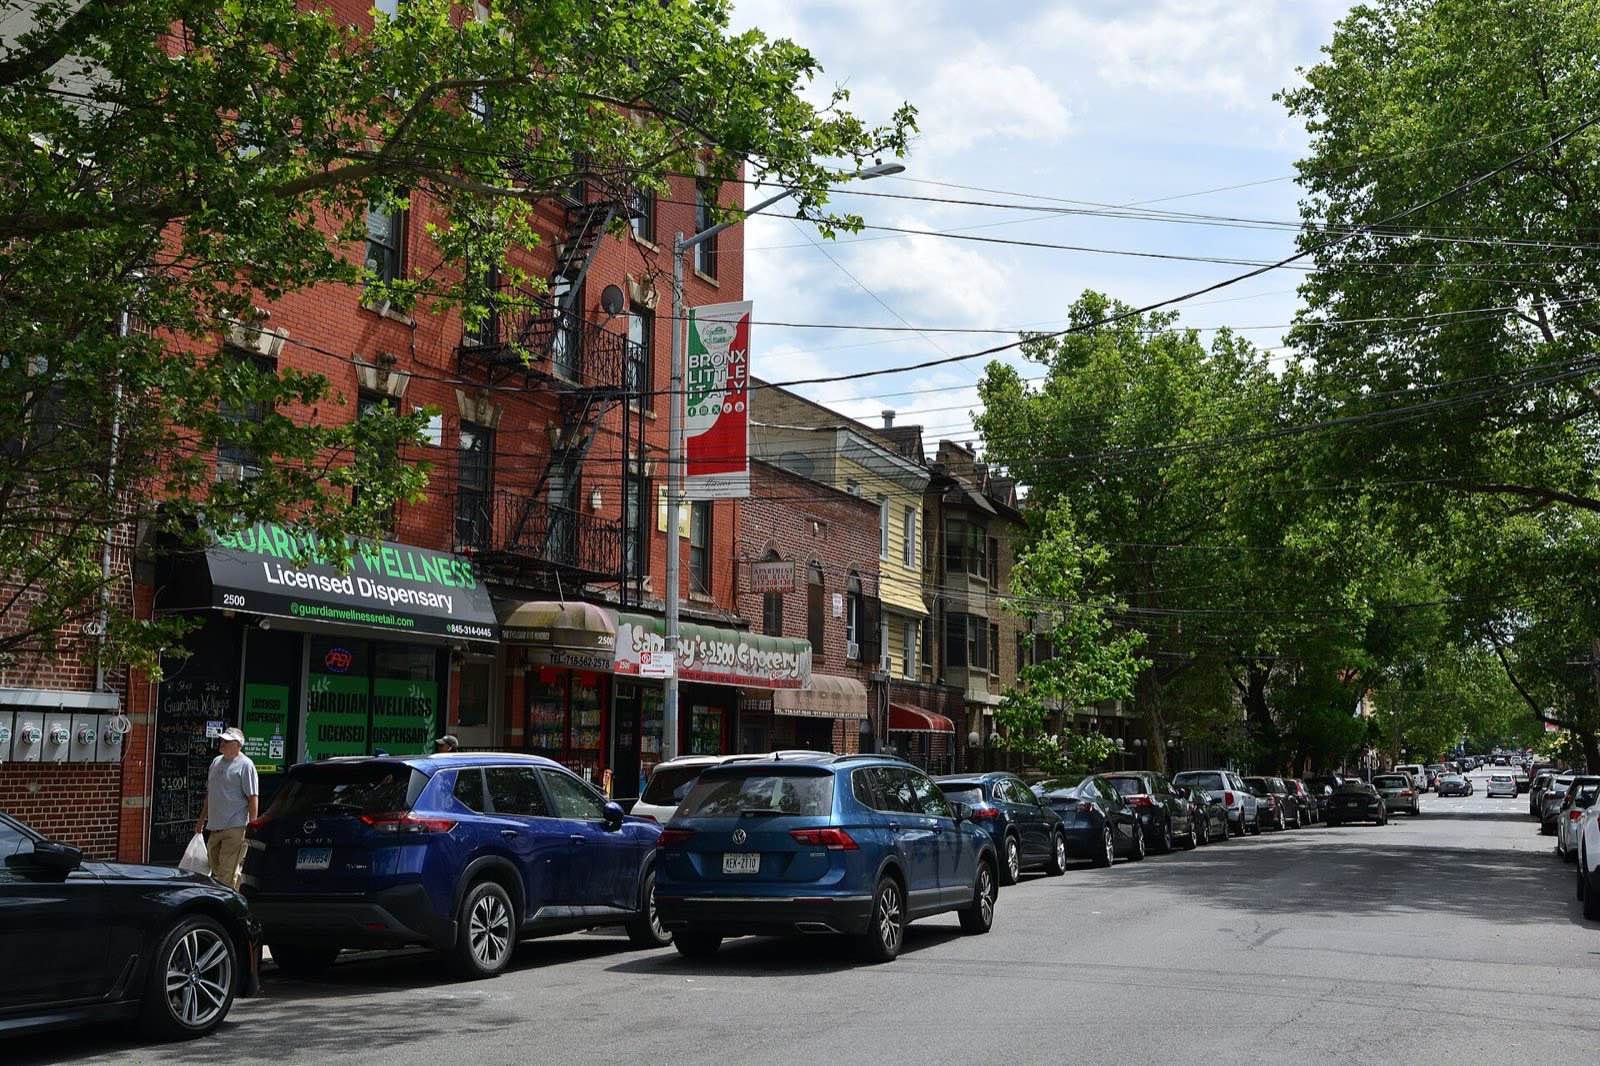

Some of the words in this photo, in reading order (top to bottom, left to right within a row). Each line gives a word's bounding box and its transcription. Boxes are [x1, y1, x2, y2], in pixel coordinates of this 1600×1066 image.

[688, 349, 746, 369] BRONX
[688, 364, 746, 385] LITTLE
[689, 380, 745, 400] ITALY
[360, 543, 477, 590] WELLNESS
[753, 567, 793, 575] APARTMENT
[263, 561, 355, 596] Licensed
[356, 576, 453, 614] Dispensary
[223, 593, 245, 607] 2500
[451, 623, 492, 638] 845-314-0445
[597, 635, 615, 646] 2500
[737, 642, 800, 679] Grocery
[318, 724, 365, 742] LICENSED
